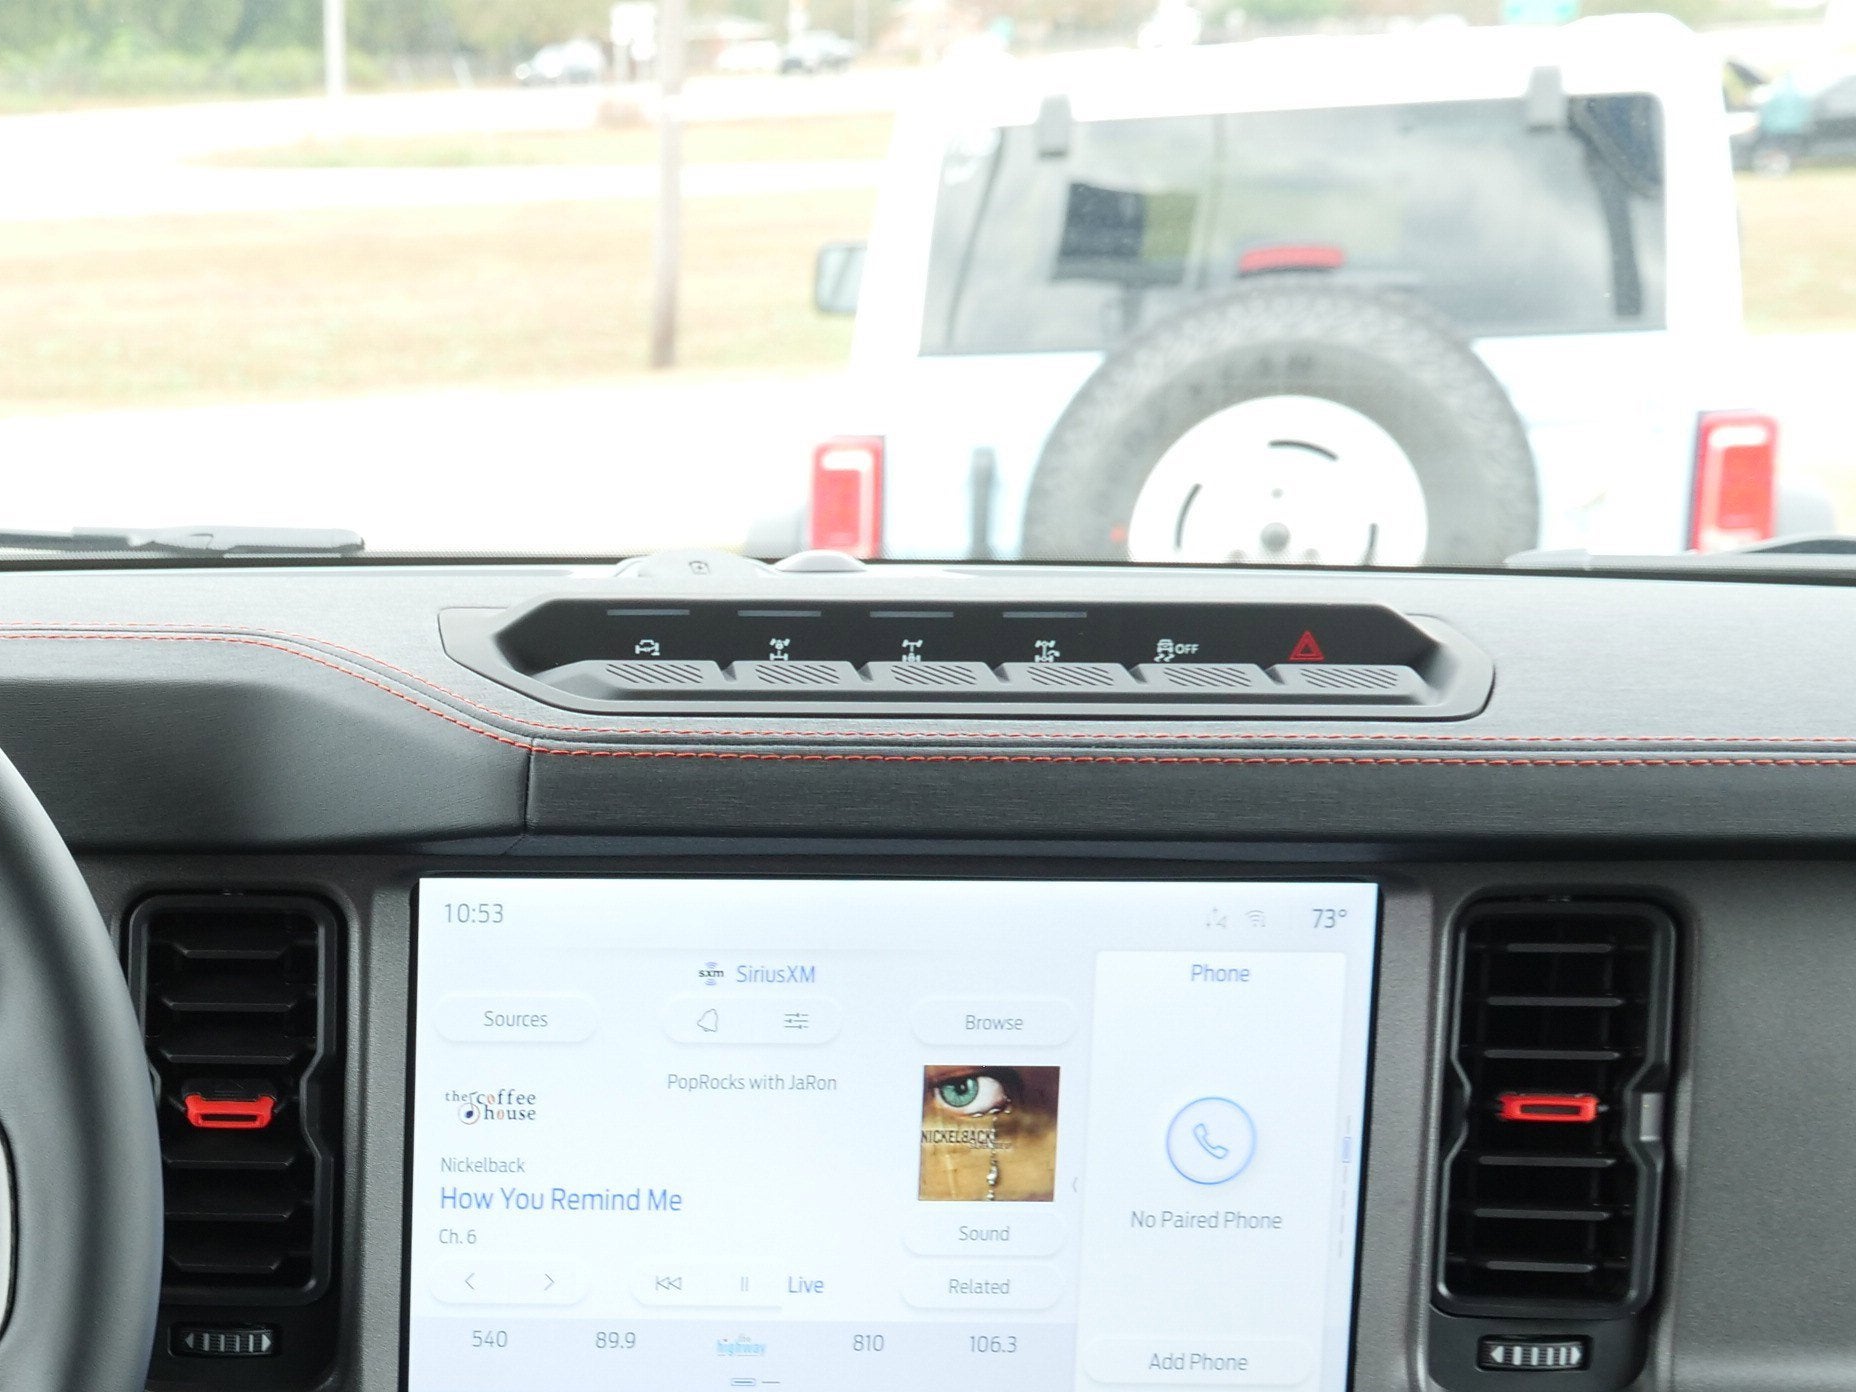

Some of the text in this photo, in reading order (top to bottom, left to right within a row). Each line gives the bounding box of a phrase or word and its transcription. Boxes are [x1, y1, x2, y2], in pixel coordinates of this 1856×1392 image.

[1175, 643, 1199, 654] OFF
[444, 903, 504, 924] 10:53
[1312, 908, 1348, 929] 73°
[736, 965, 815, 983] SiriusXM
[1190, 964, 1251, 983] Phone
[483, 1010, 548, 1028] Sources
[965, 1014, 1024, 1032] Browse
[667, 1073, 837, 1092] PopRocks with JaRon
[445, 1088, 536, 1105] the coffee
[484, 1104, 536, 1120] house
[440, 1157, 526, 1173] Nickelback
[440, 1186, 684, 1211] How You Remind Me
[1131, 1210, 1282, 1230] No Paired Phone
[438, 1229, 477, 1245] Ch. 6
[958, 1225, 1011, 1242] Sound
[787, 1276, 825, 1294] Live
[948, 1278, 1011, 1295] Related
[471, 1330, 509, 1348] 540
[595, 1331, 637, 1349] 89.9
[853, 1335, 885, 1352] 810
[970, 1336, 1018, 1354] 106.3
[1148, 1353, 1248, 1372] Add Phone
